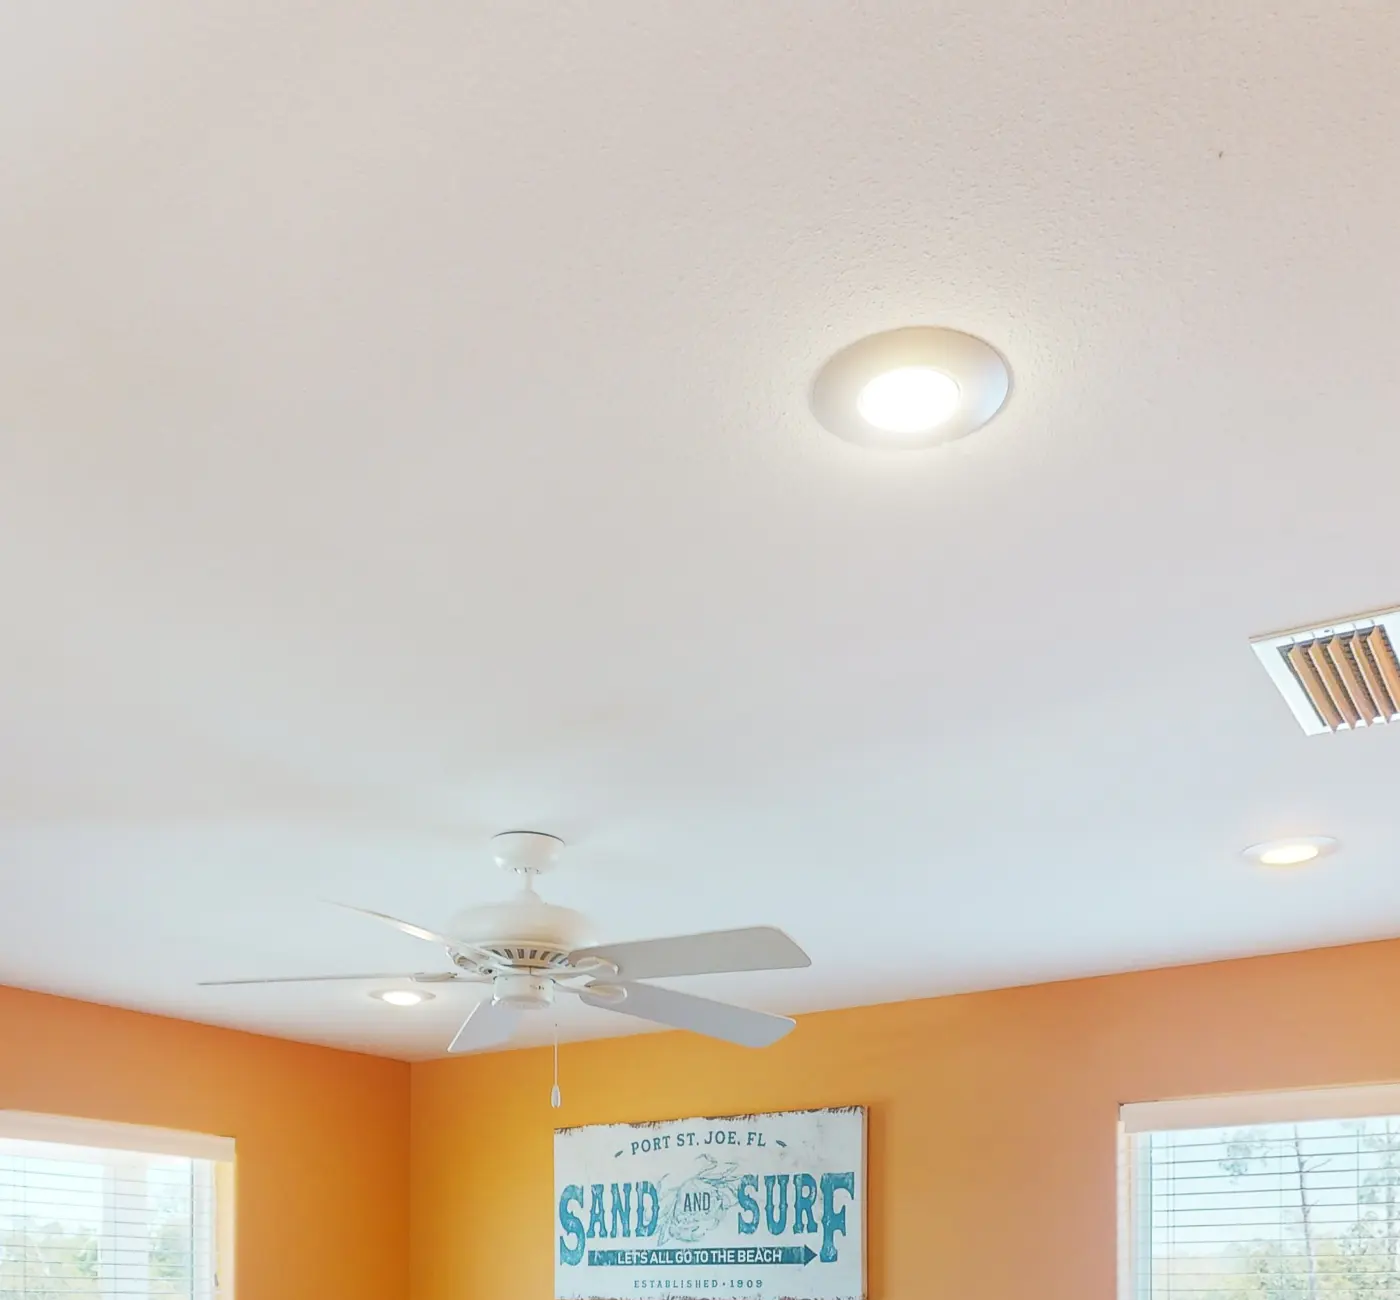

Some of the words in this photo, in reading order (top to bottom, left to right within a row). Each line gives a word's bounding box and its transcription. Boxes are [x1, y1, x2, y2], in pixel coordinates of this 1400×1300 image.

[631, 1136, 671, 1155] PORT
[677, 1133, 699, 1146] ST.
[747, 1133, 766, 1147] FL
[559, 1180, 660, 1266] SAND
[683, 1192, 710, 1212] AND
[738, 1172, 855, 1263] SURF
[650, 1252, 673, 1264] ALL
[676, 1251, 692, 1263] GO
[695, 1251, 708, 1263] TO
[710, 1250, 736, 1262] THE
[738, 1249, 782, 1262] BEACH
[634, 1279, 718, 1288] ESTABLISHED
[730, 1279, 763, 1288] 1909
